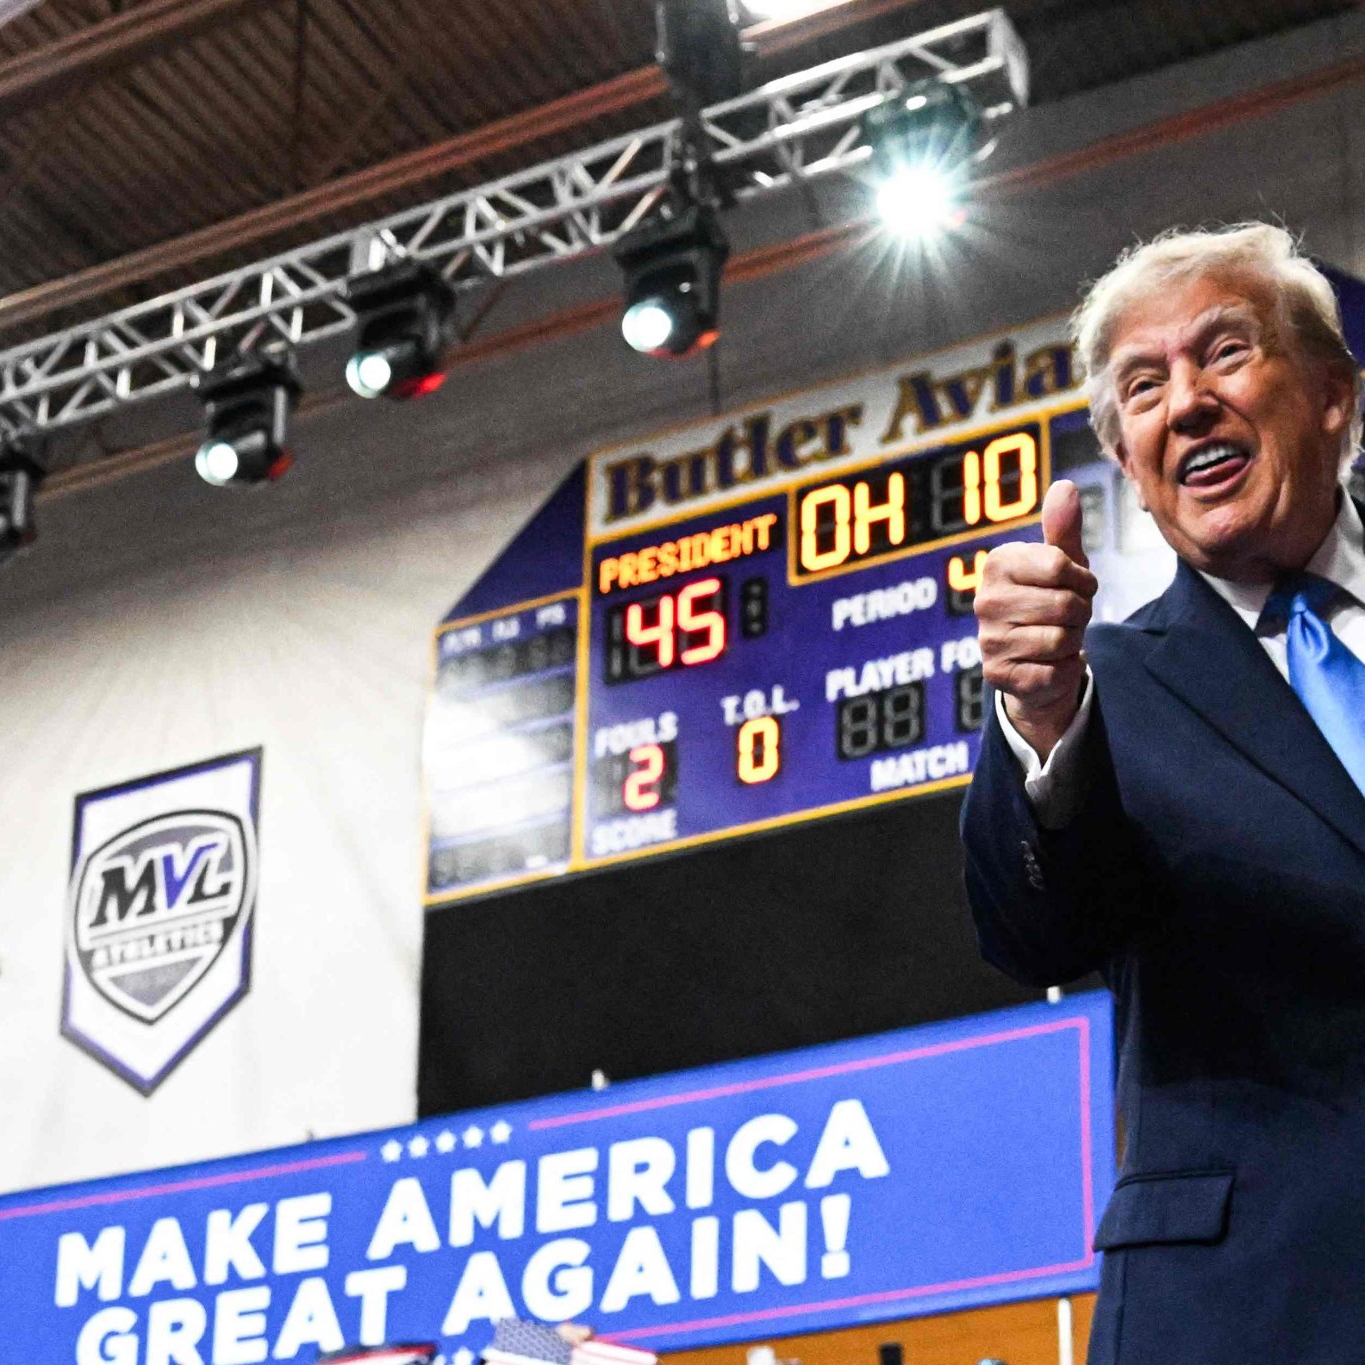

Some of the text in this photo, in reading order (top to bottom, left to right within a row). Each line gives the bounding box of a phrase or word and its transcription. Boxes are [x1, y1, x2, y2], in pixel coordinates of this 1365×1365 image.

[603, 399, 862, 524] Butler
[598, 514, 778, 593] PRESIDENT
[626, 578, 727, 668] 45
[831, 577, 938, 631] PERIOD
[825, 647, 935, 701] PLAYER
[595, 712, 678, 758] FOULS
[737, 715, 780, 785] 0
[870, 742, 970, 792] MATCH
[623, 744, 665, 812] 2
[592, 810, 679, 858] SCORE
[89, 842, 233, 928] MVL
[54, 1098, 890, 1307] MAKE AMERICA
[441, 1193, 851, 1336] AGAIN!
